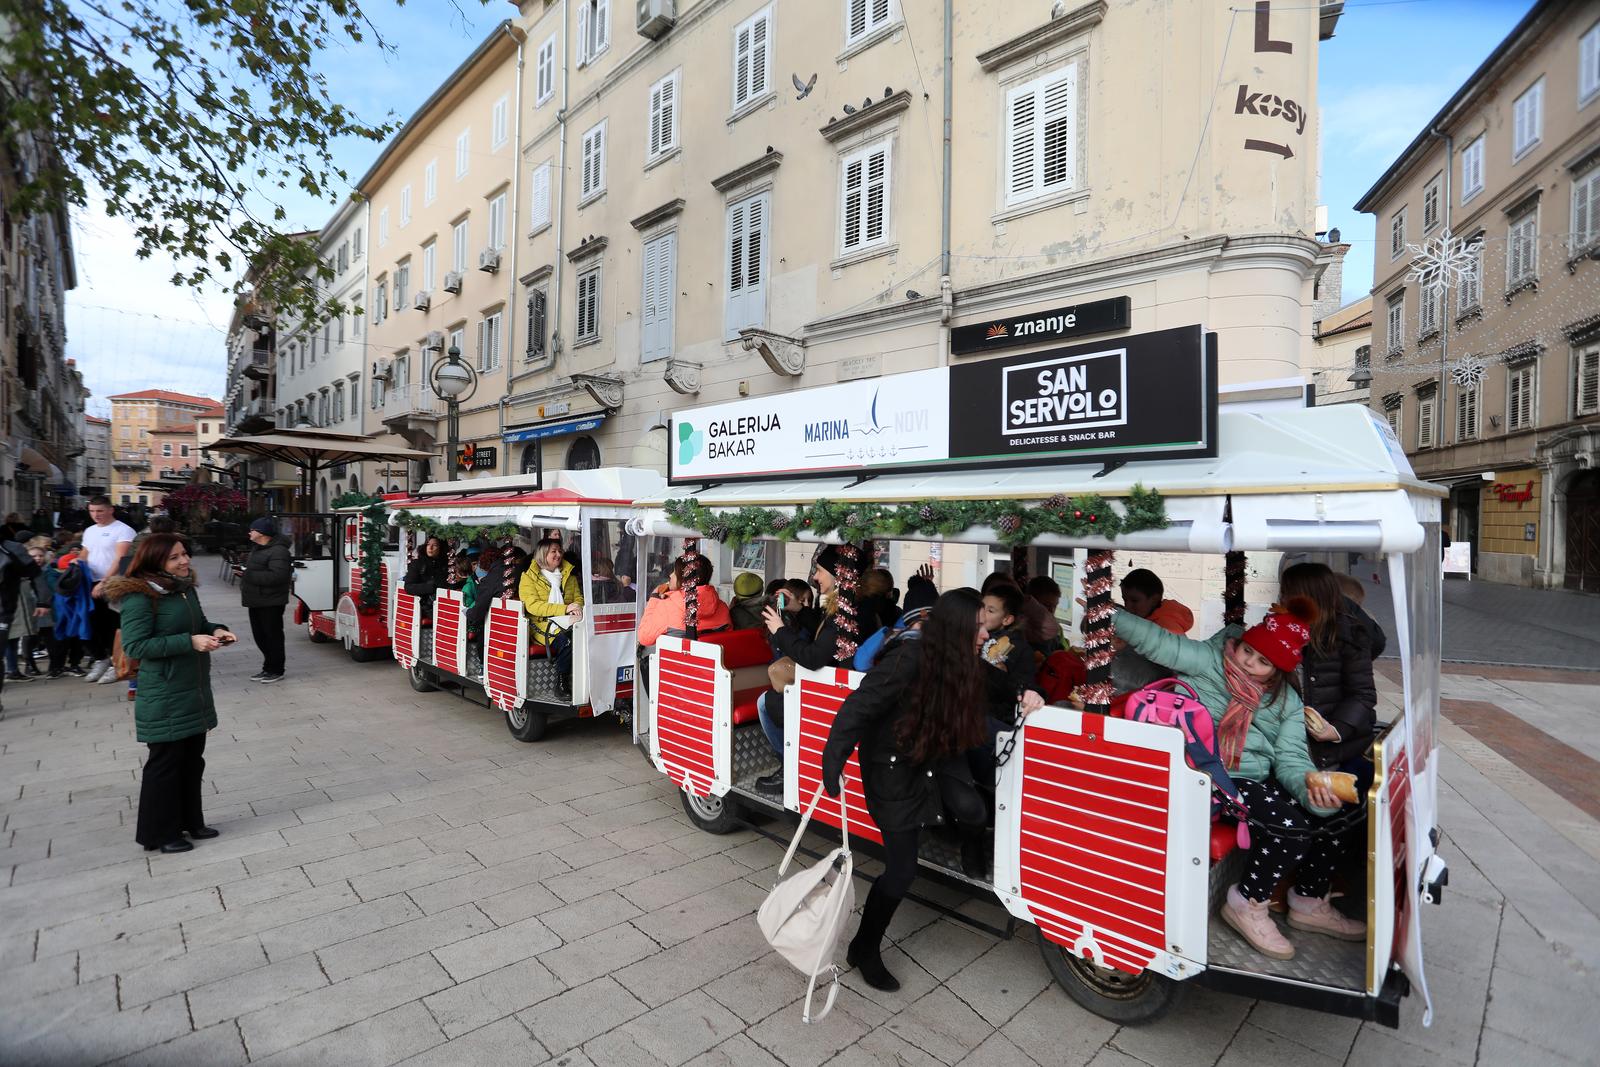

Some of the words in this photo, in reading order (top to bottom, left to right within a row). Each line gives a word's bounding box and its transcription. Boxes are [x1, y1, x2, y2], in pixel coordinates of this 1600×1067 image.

[1254, 1, 1293, 54] L
[1234, 84, 1307, 136] kosy
[1014, 311, 1077, 337] znanje
[1037, 364, 1087, 396] SAN
[1010, 388, 1117, 425] SERVOLO
[708, 413, 781, 438] GALERIJA
[804, 419, 850, 443] MARINA
[894, 408, 929, 434] NOVI
[1009, 435, 1059, 446] DELICATESSE
[1060, 434, 1067, 443] &
[1068, 432, 1096, 442] SNACK
[1098, 431, 1116, 440] BAR
[476, 450, 491, 459] STREET
[708, 438, 756, 459] BAKAR
[476, 458, 491, 466] FOOD
